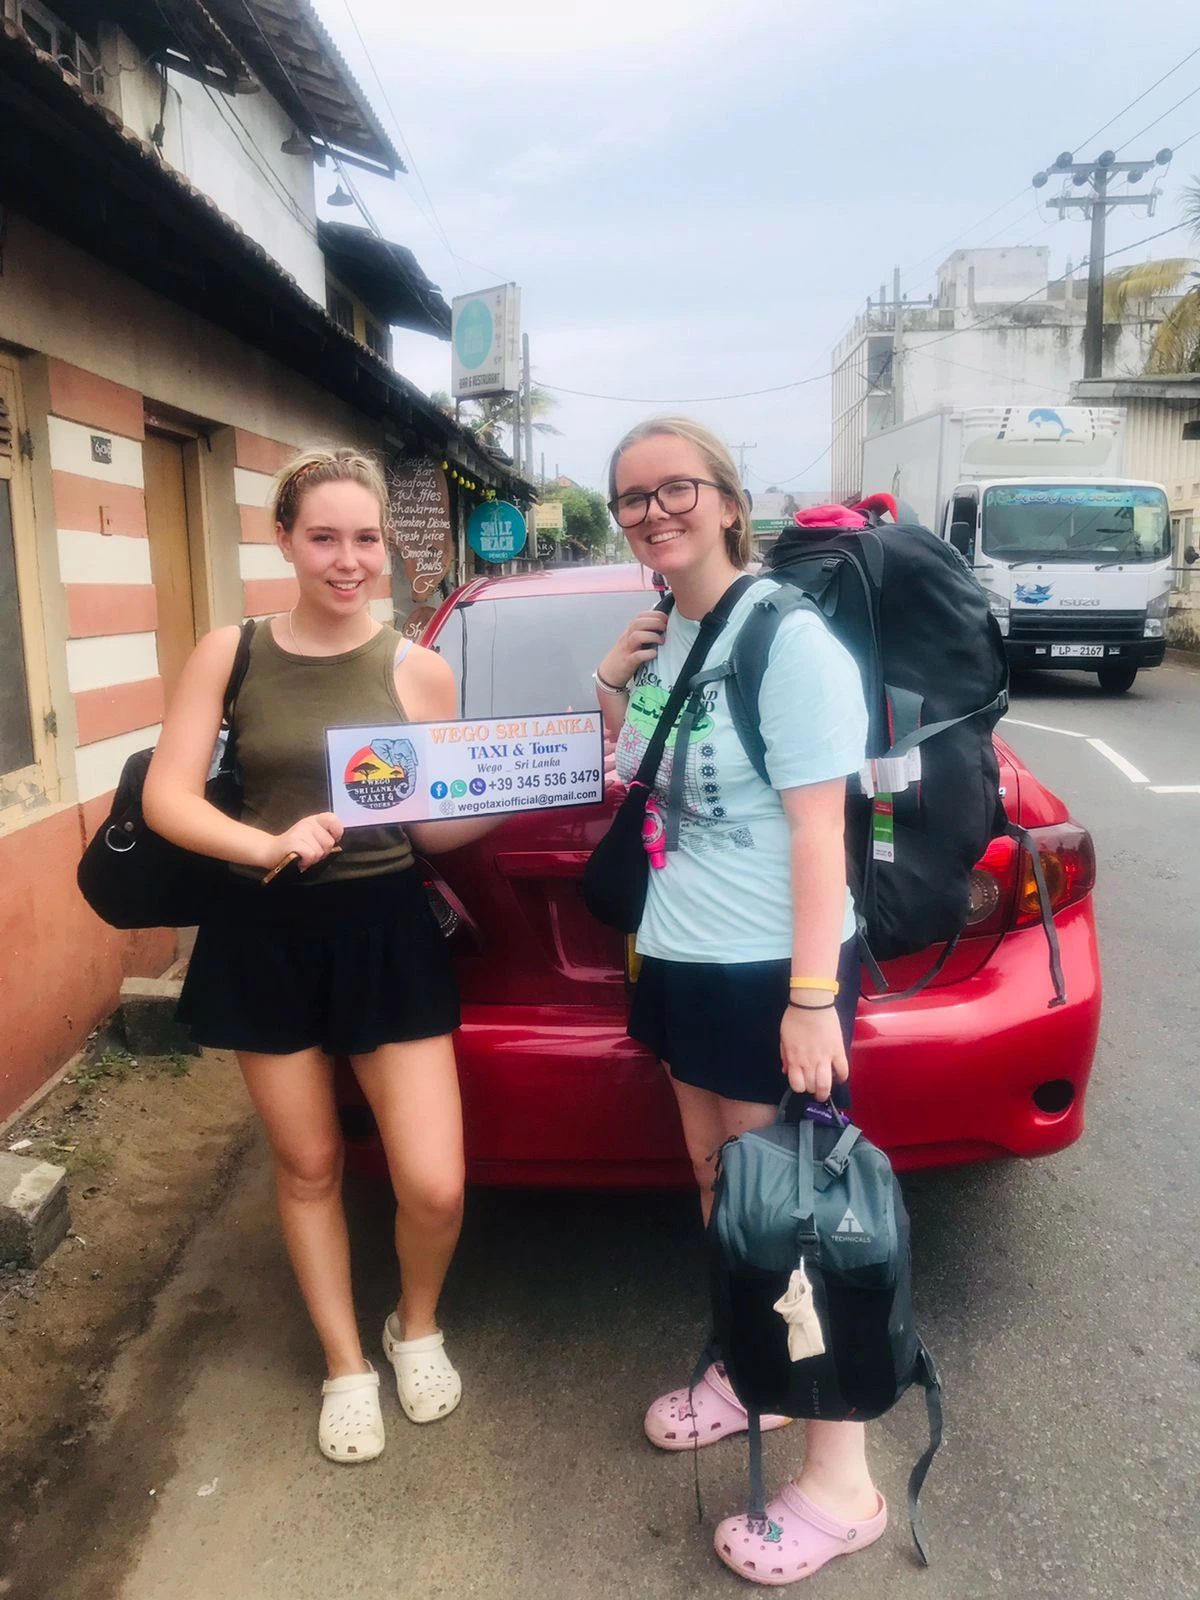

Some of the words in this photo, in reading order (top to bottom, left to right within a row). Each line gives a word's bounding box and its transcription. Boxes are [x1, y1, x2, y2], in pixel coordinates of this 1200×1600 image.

[391, 502, 445, 514] Shawarma
[480, 520, 512, 536] SMILE
[395, 531, 419, 544] Fresh
[419, 530, 445, 545] juice
[480, 536, 514, 551] BEACH
[431, 727, 489, 744] WEGO
[495, 722, 527, 740] SRI
[533, 718, 596, 737] LANKA
[468, 744, 508, 759] TAXI
[513, 744, 524, 757] &
[529, 741, 568, 755] Tours
[477, 763, 503, 774] Wego
[514, 760, 529, 770] Sri
[532, 758, 561, 769] Lanka
[489, 777, 513, 791] +39
[517, 775, 540, 789] 345
[544, 772, 567, 787] 536
[570, 769, 600, 784] 3479
[354, 787, 368, 795] SRI
[370, 785, 397, 793] LANKA
[359, 794, 386, 803] TAXI
[458, 790, 597, 813] wegotaxiofficial@gmail.com
